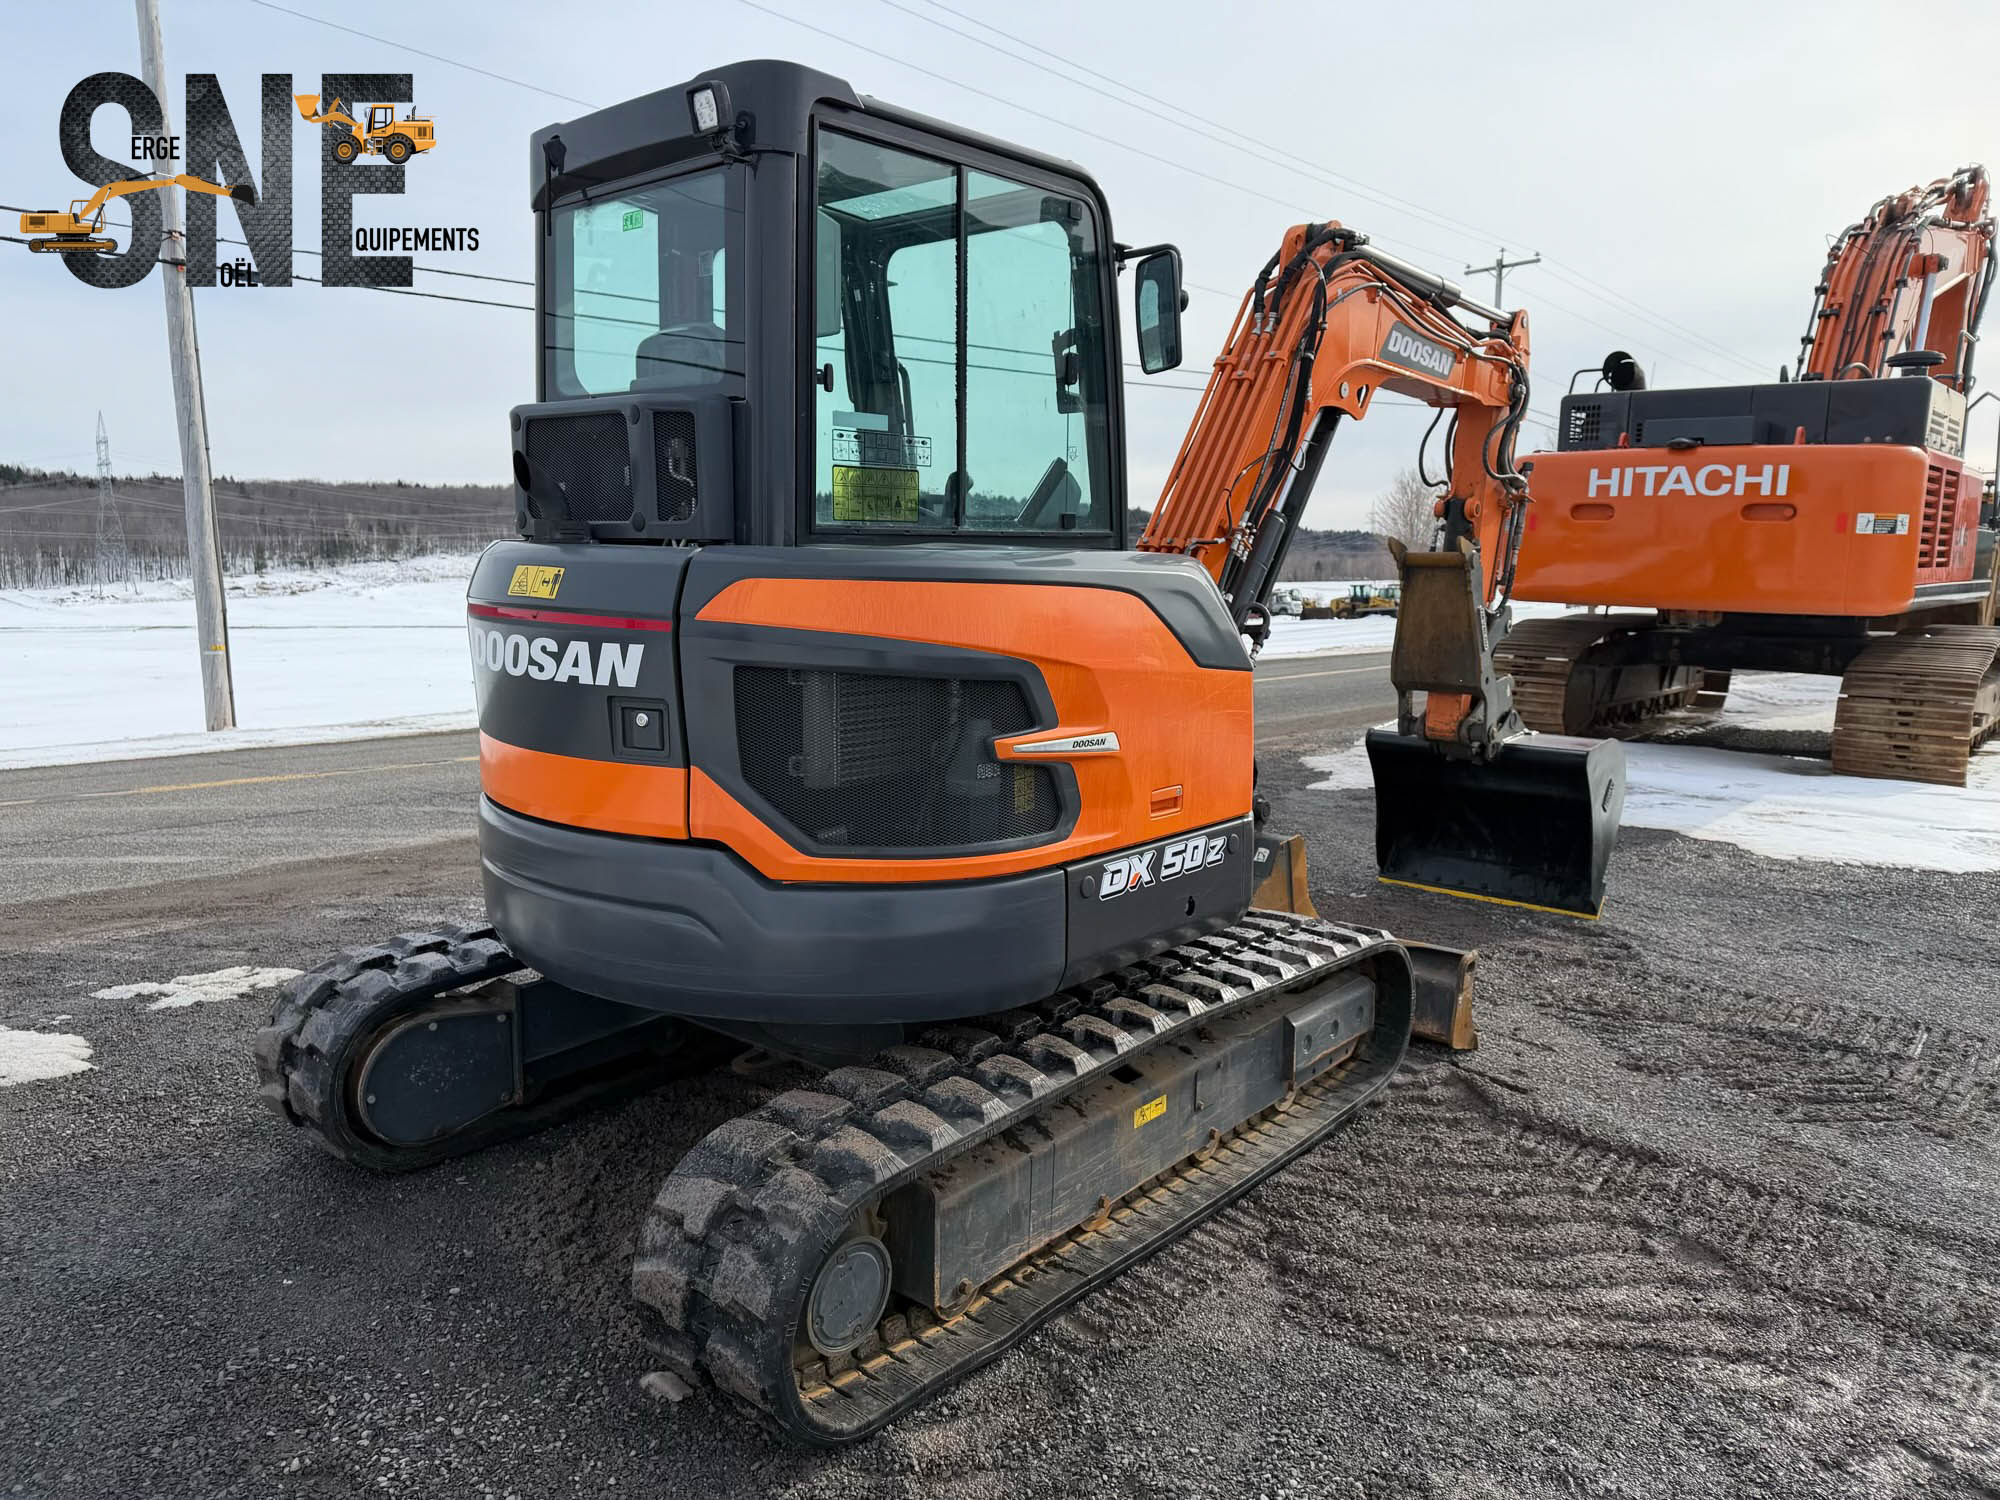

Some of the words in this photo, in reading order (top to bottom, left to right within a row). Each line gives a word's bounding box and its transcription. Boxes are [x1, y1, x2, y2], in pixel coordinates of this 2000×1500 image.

[1387, 329, 1453, 376] DOOSAN
[1587, 464, 1790, 498] HITACHI
[471, 626, 645, 688] DOOSAN
[1072, 737, 1107, 749] DOOSAN
[1099, 849, 1157, 902] DX
